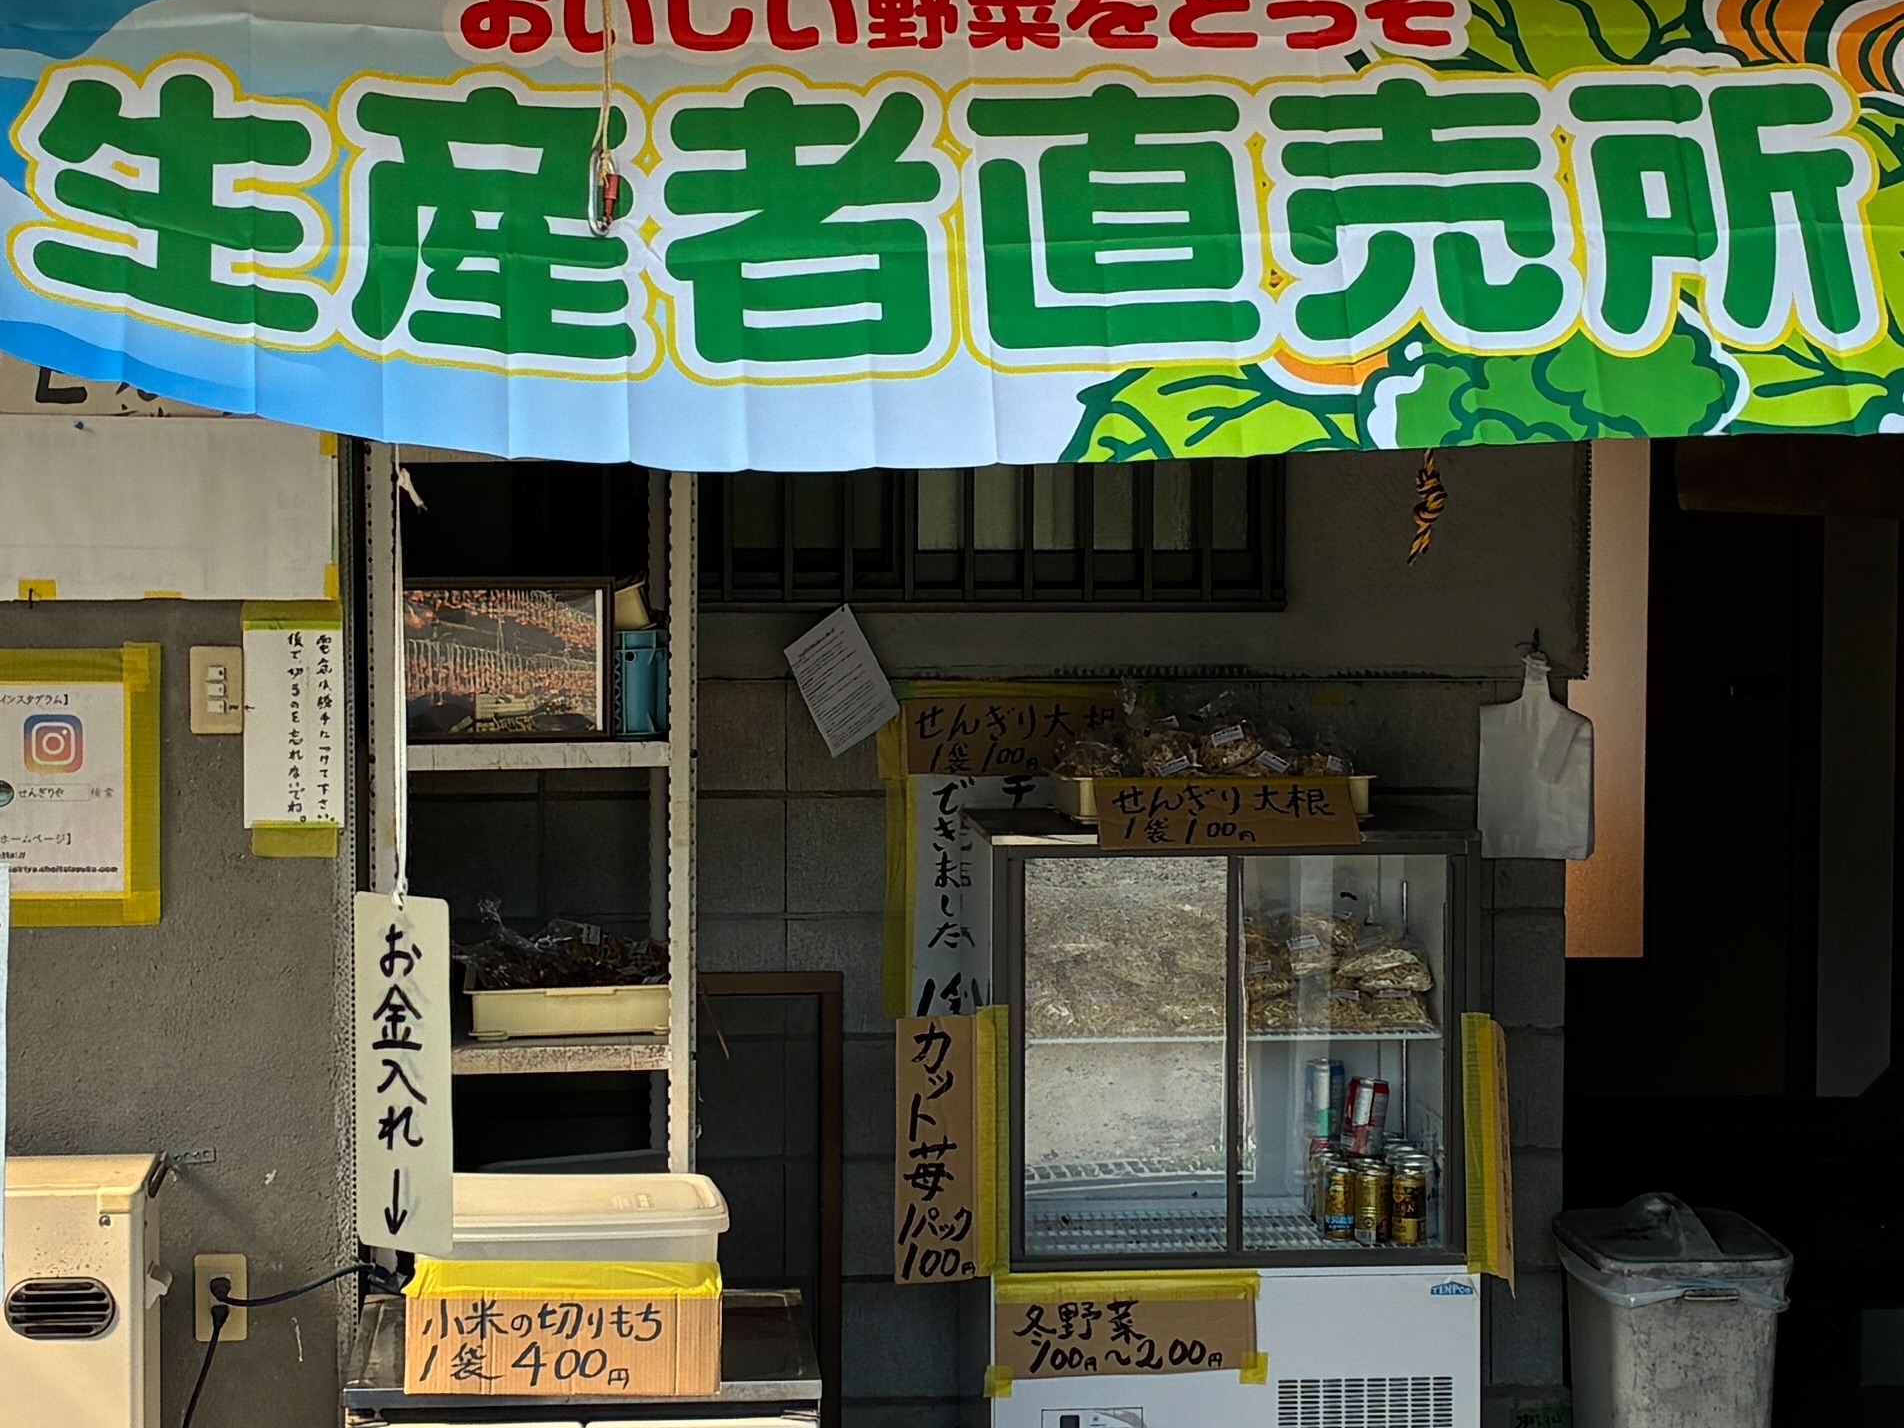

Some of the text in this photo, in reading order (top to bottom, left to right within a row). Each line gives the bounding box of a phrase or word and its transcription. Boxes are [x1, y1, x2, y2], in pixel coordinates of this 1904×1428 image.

[32, 74, 1857, 354] 生産者直売所
[1112, 784, 1335, 819] せんぎり大根
[371, 921, 428, 1152] お金入れ
[422, 1297, 663, 1342] 小米の切りもち
[1013, 1299, 1146, 1347] 冬野菜
